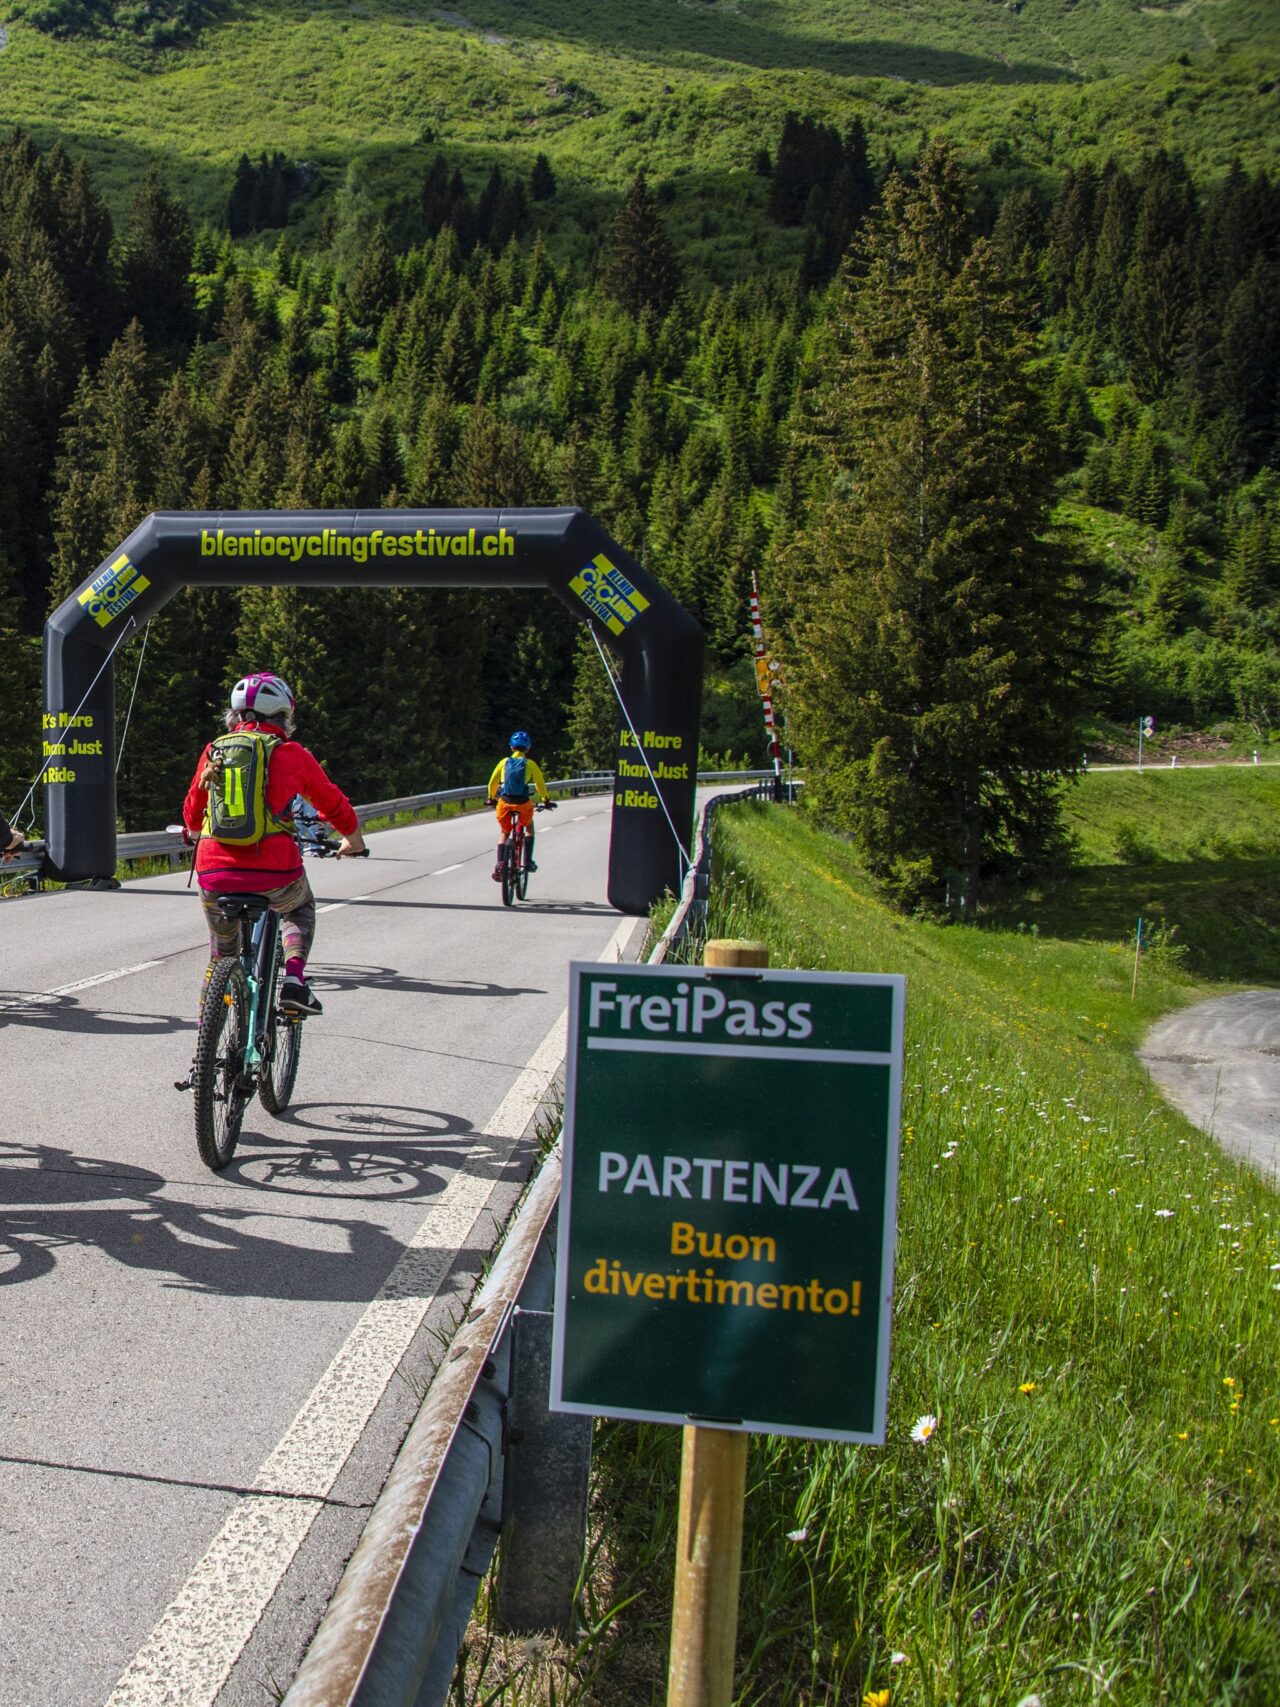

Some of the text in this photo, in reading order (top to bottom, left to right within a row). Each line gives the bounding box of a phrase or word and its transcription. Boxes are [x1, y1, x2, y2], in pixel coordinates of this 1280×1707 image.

[200, 528, 515, 563] bleniocyclingfestival.ch
[91, 567, 116, 593] BLENIO
[607, 568, 635, 597] BLENIO
[106, 586, 138, 617] FESTIVAL
[581, 587, 613, 624] FESTIVAL
[58, 712, 94, 728] More
[68, 738, 103, 755] Just
[643, 730, 682, 749] More
[48, 766, 76, 783] Ride
[618, 759, 689, 779] Than Just
[616, 789, 658, 809] a Ride
[588, 981, 813, 1039] FreiPass
[598, 1151, 860, 1212] PARTENZA
[670, 1221, 777, 1263] Buon
[583, 1258, 862, 1316] divertimento!
